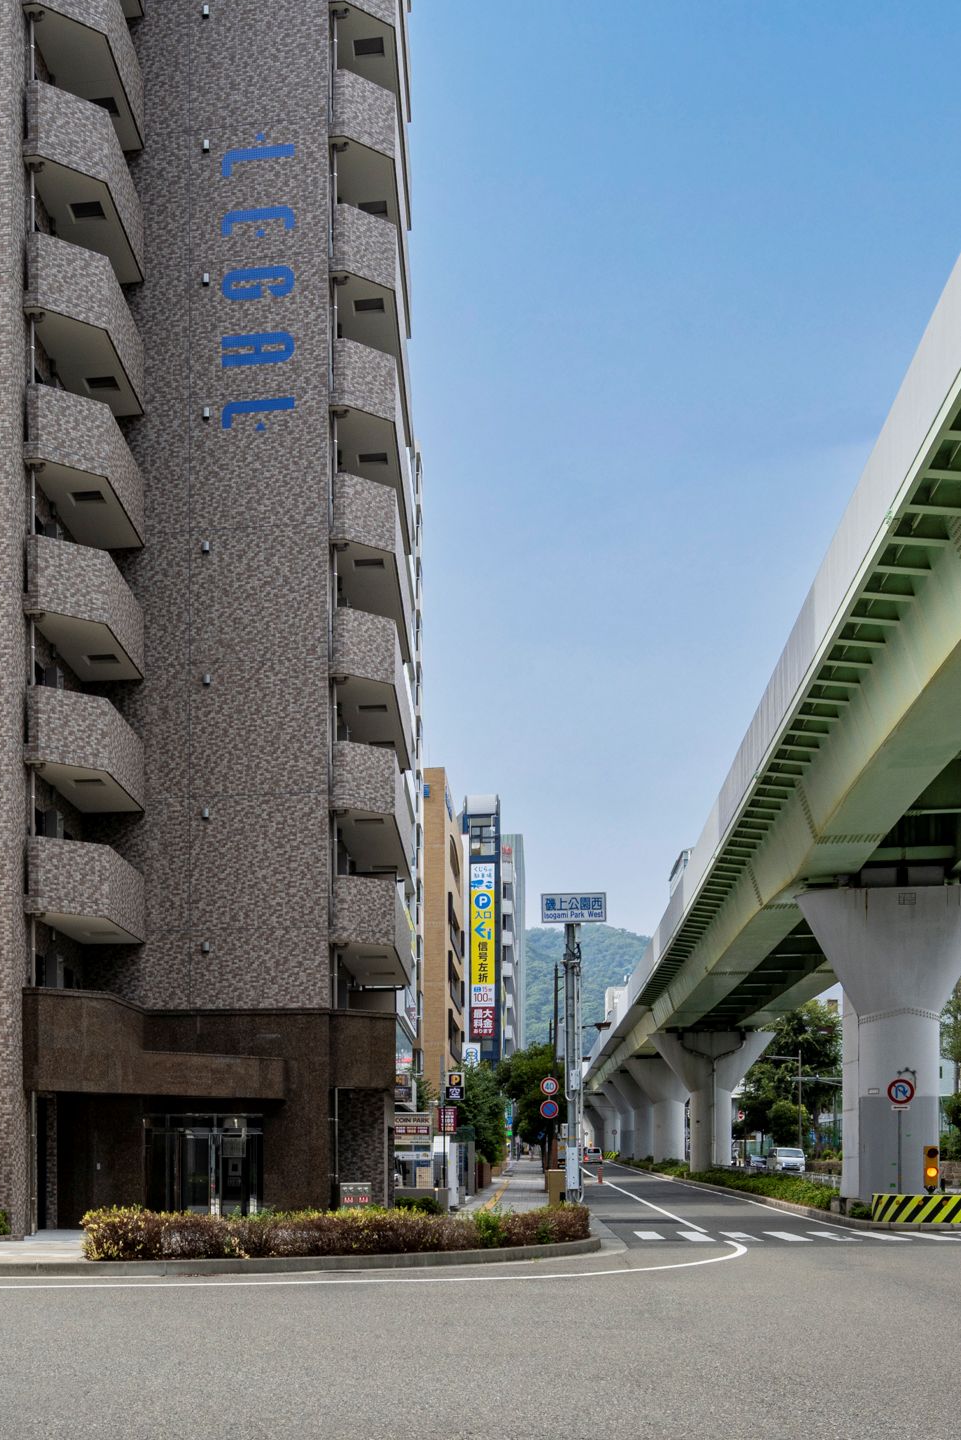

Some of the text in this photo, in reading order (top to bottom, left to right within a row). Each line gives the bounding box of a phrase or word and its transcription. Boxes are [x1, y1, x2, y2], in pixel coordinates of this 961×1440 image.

[221, 132, 295, 432] LEGAL
[479, 896, 487, 906] P
[475, 911, 492, 919] 入口
[544, 910, 604, 920] Isogami Park West
[478, 941, 489, 983] 信号左折
[473, 1019, 493, 1029] 料金
[451, 1074, 461, 1086] P
[545, 1082, 554, 1090] 40
